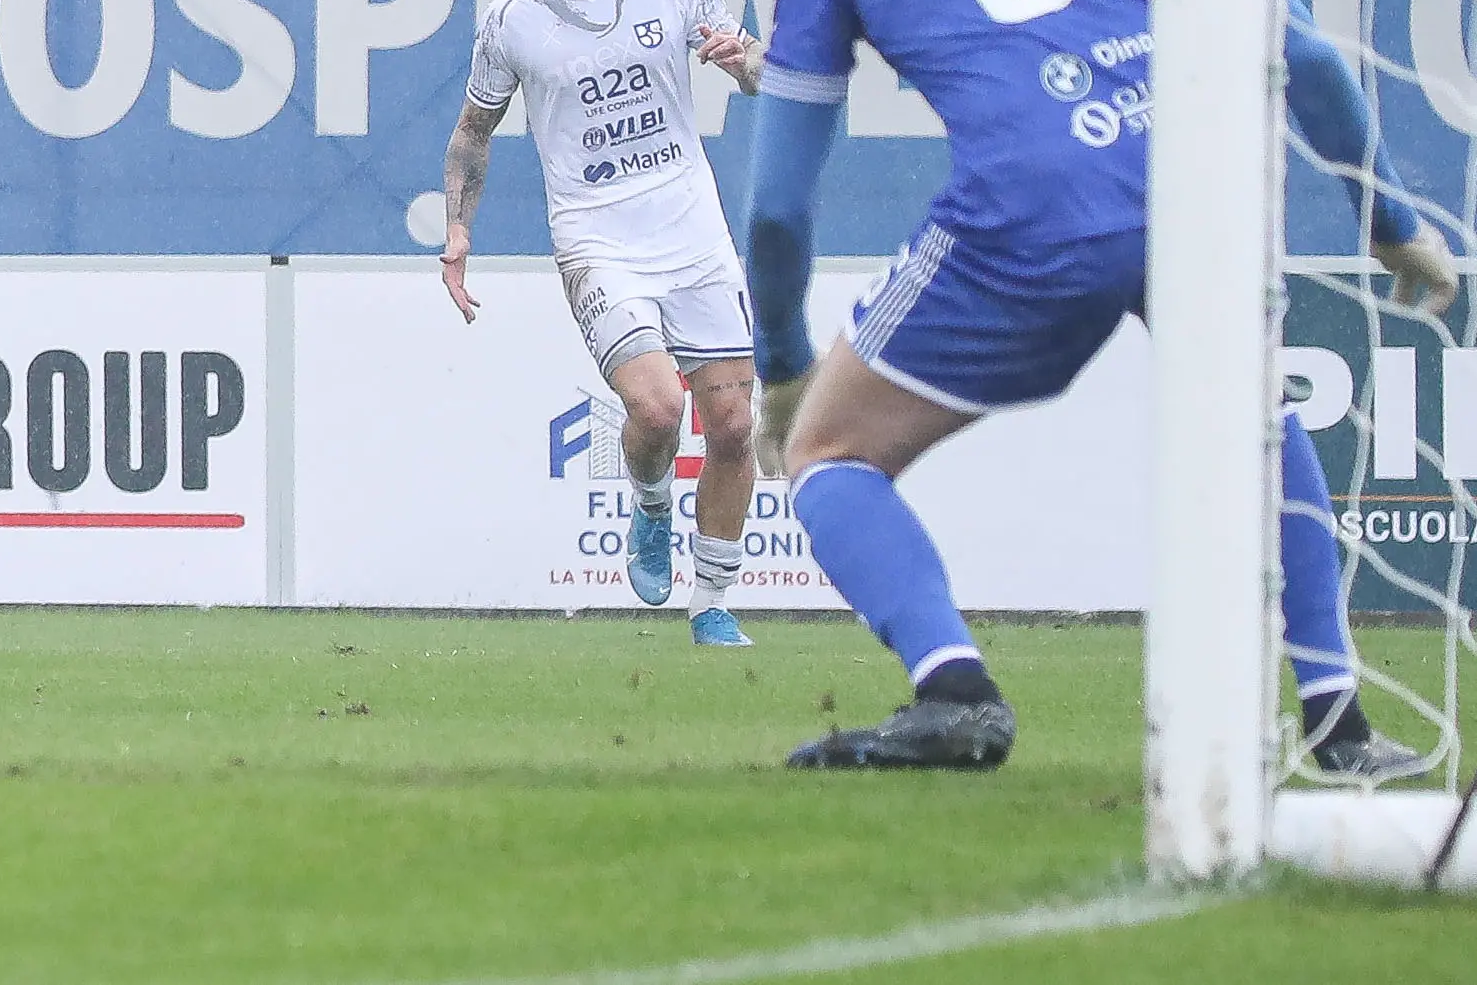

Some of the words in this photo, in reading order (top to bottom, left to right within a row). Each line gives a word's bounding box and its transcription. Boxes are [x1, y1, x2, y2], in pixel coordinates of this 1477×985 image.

[577, 63, 652, 105] a2a
[585, 105, 606, 118] LIFE
[606, 91, 654, 112] COMPANY
[620, 141, 682, 176] Marsh
[550, 570, 575, 585] LA
[583, 570, 623, 585] TUA
[742, 570, 810, 586] OSTRO
